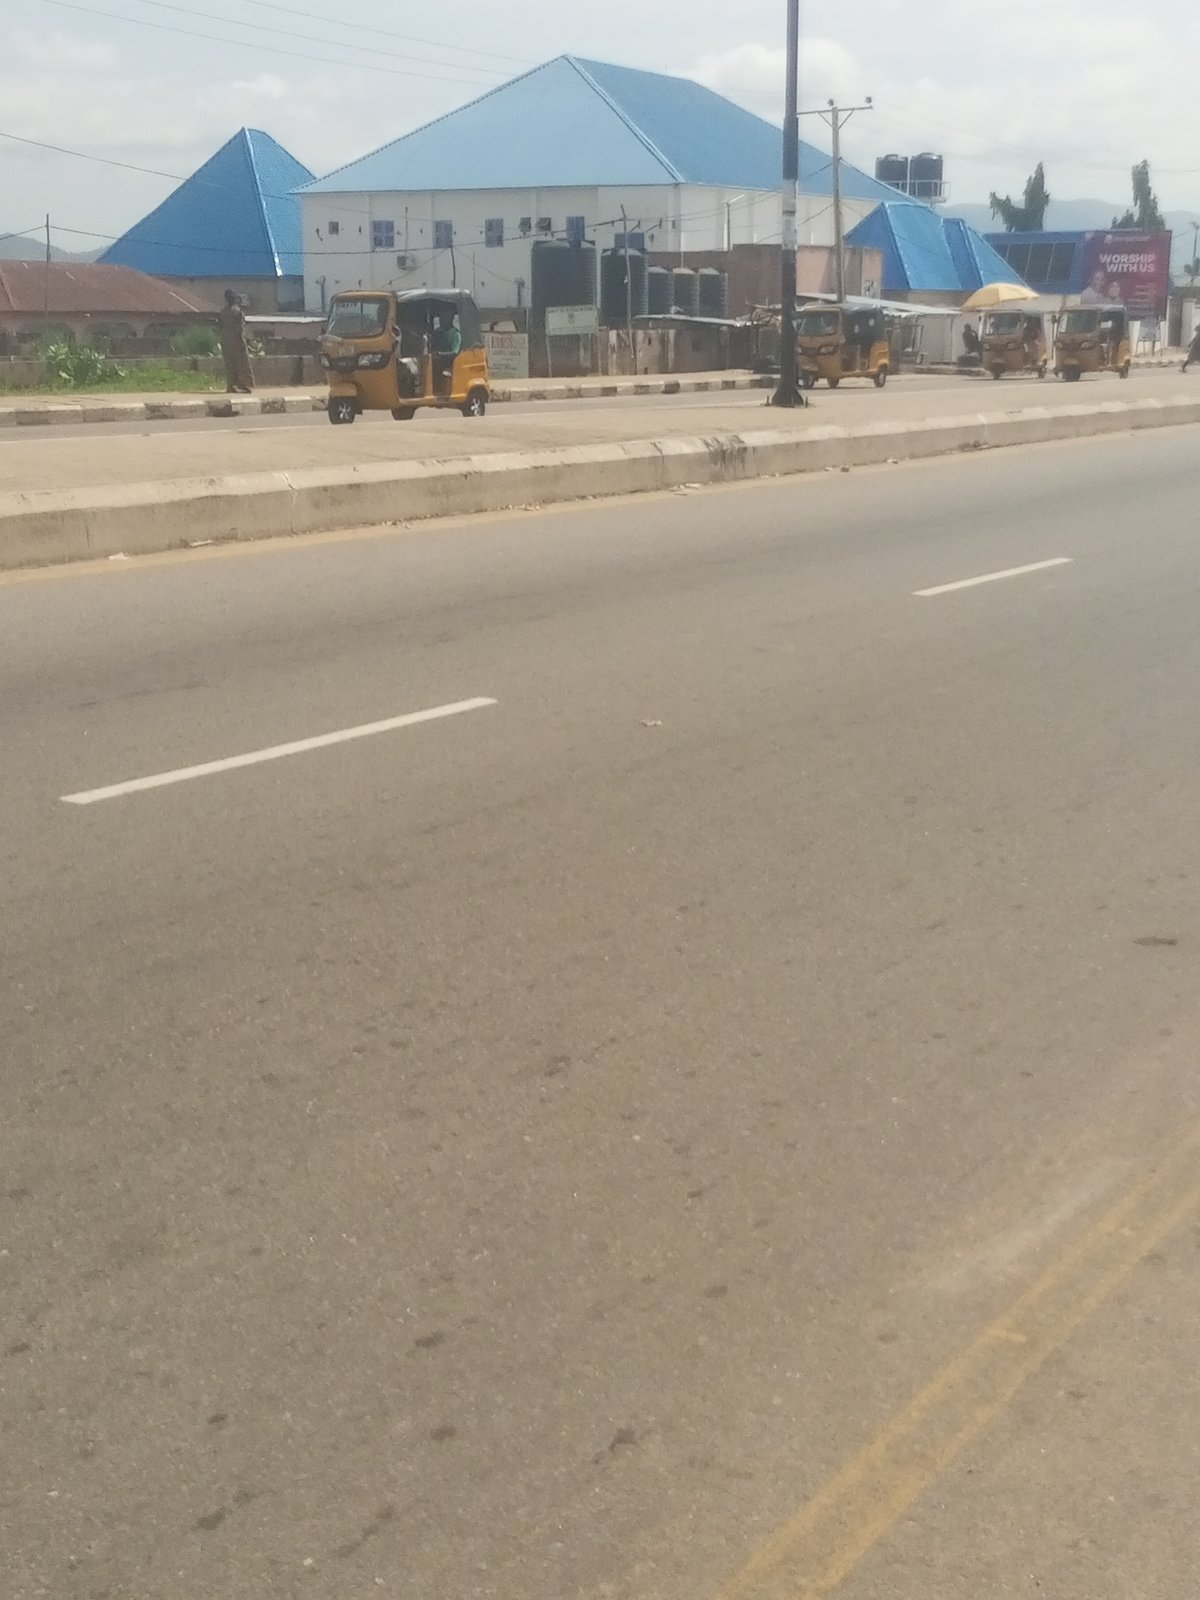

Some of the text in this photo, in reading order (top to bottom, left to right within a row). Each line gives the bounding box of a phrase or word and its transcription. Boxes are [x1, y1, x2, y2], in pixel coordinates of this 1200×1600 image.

[1099, 253, 1155, 264] WORSHIP
[1106, 263, 1155, 273] WITH US
